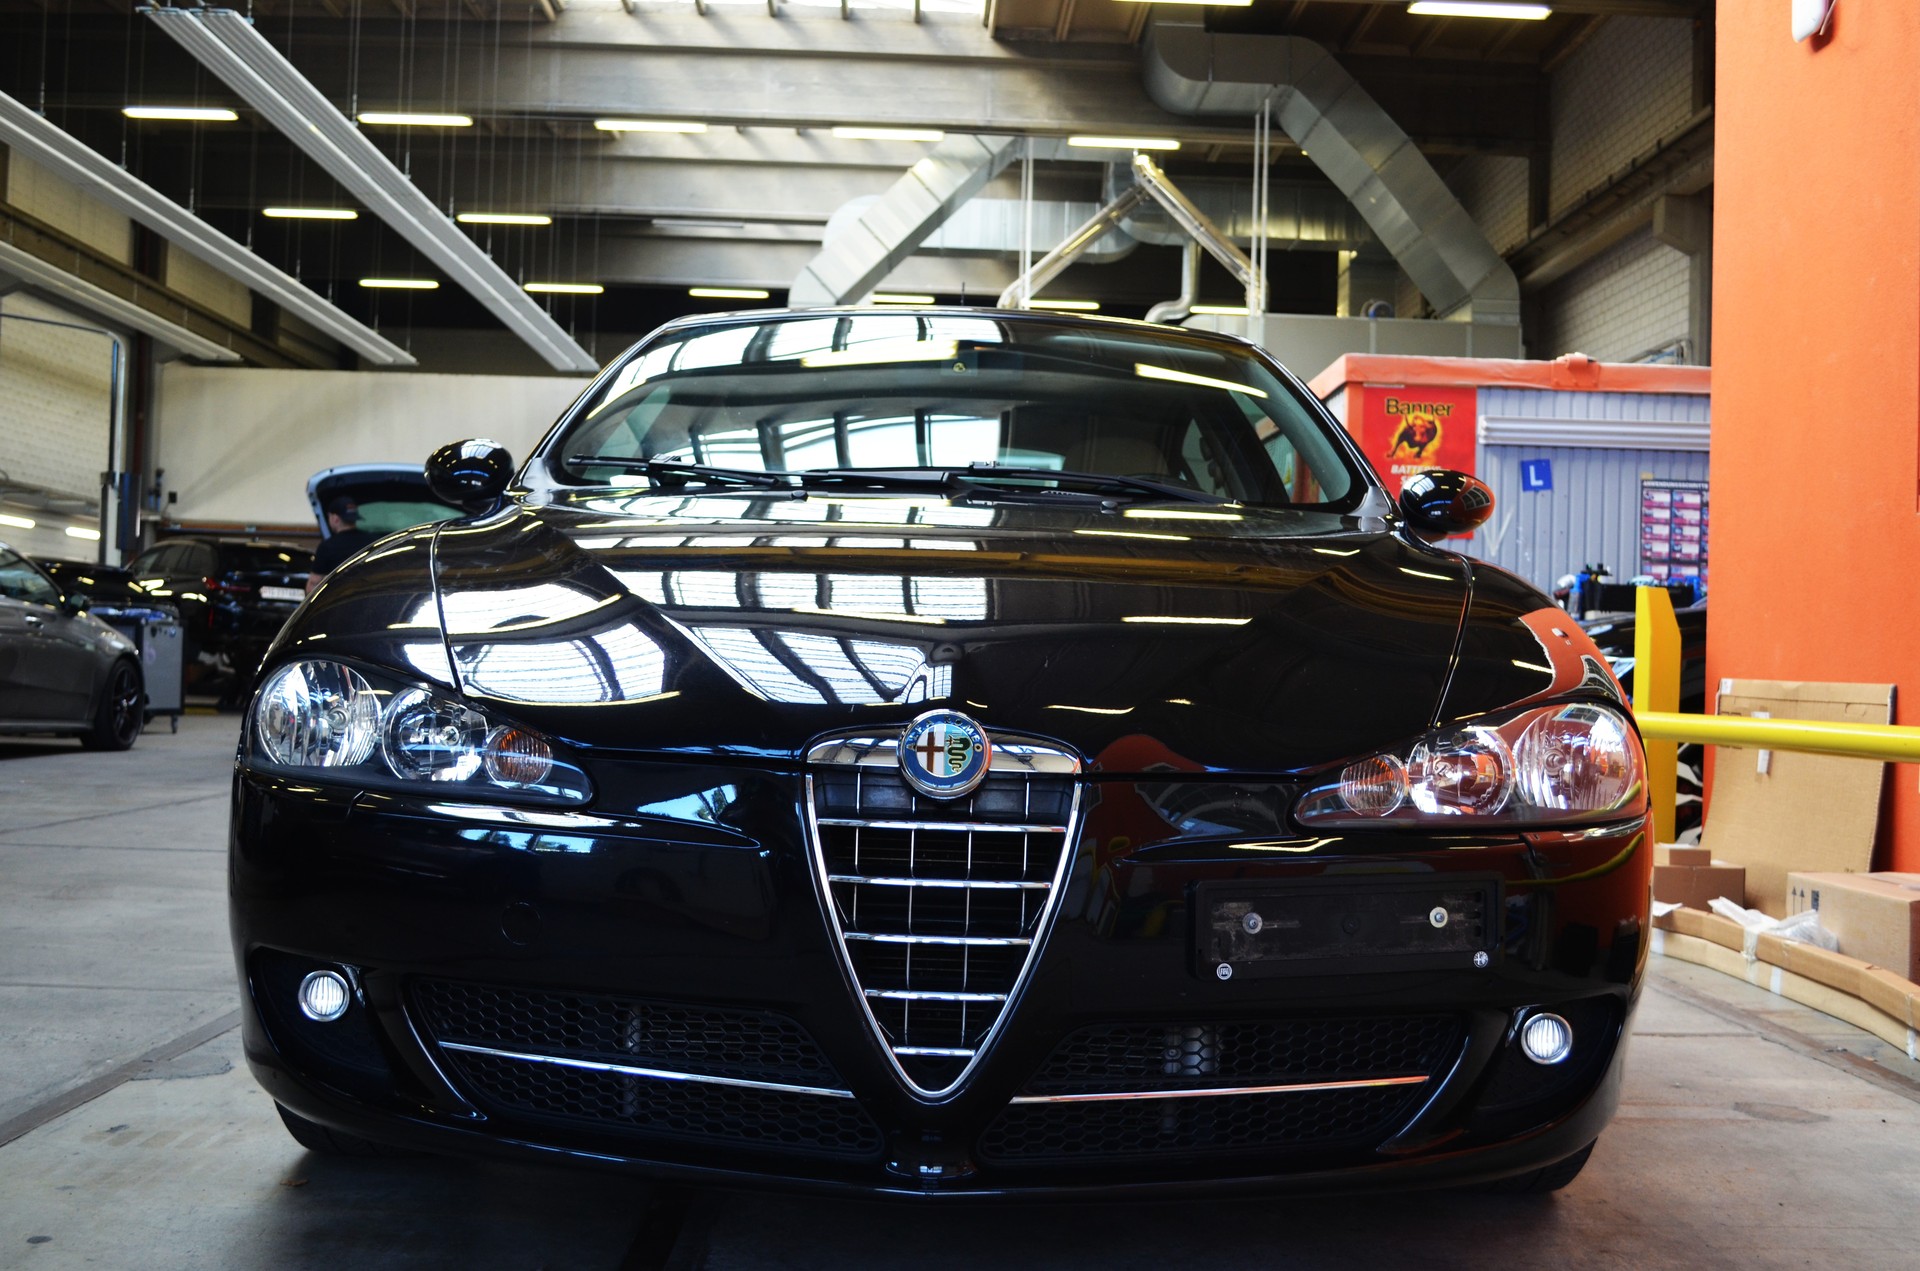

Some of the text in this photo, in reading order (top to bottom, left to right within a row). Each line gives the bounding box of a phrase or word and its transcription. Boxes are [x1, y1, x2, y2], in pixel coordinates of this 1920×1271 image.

[1386, 397, 1454, 417] Banner
[1529, 464, 1544, 486] L
[943, 715, 984, 753] ROMEO
